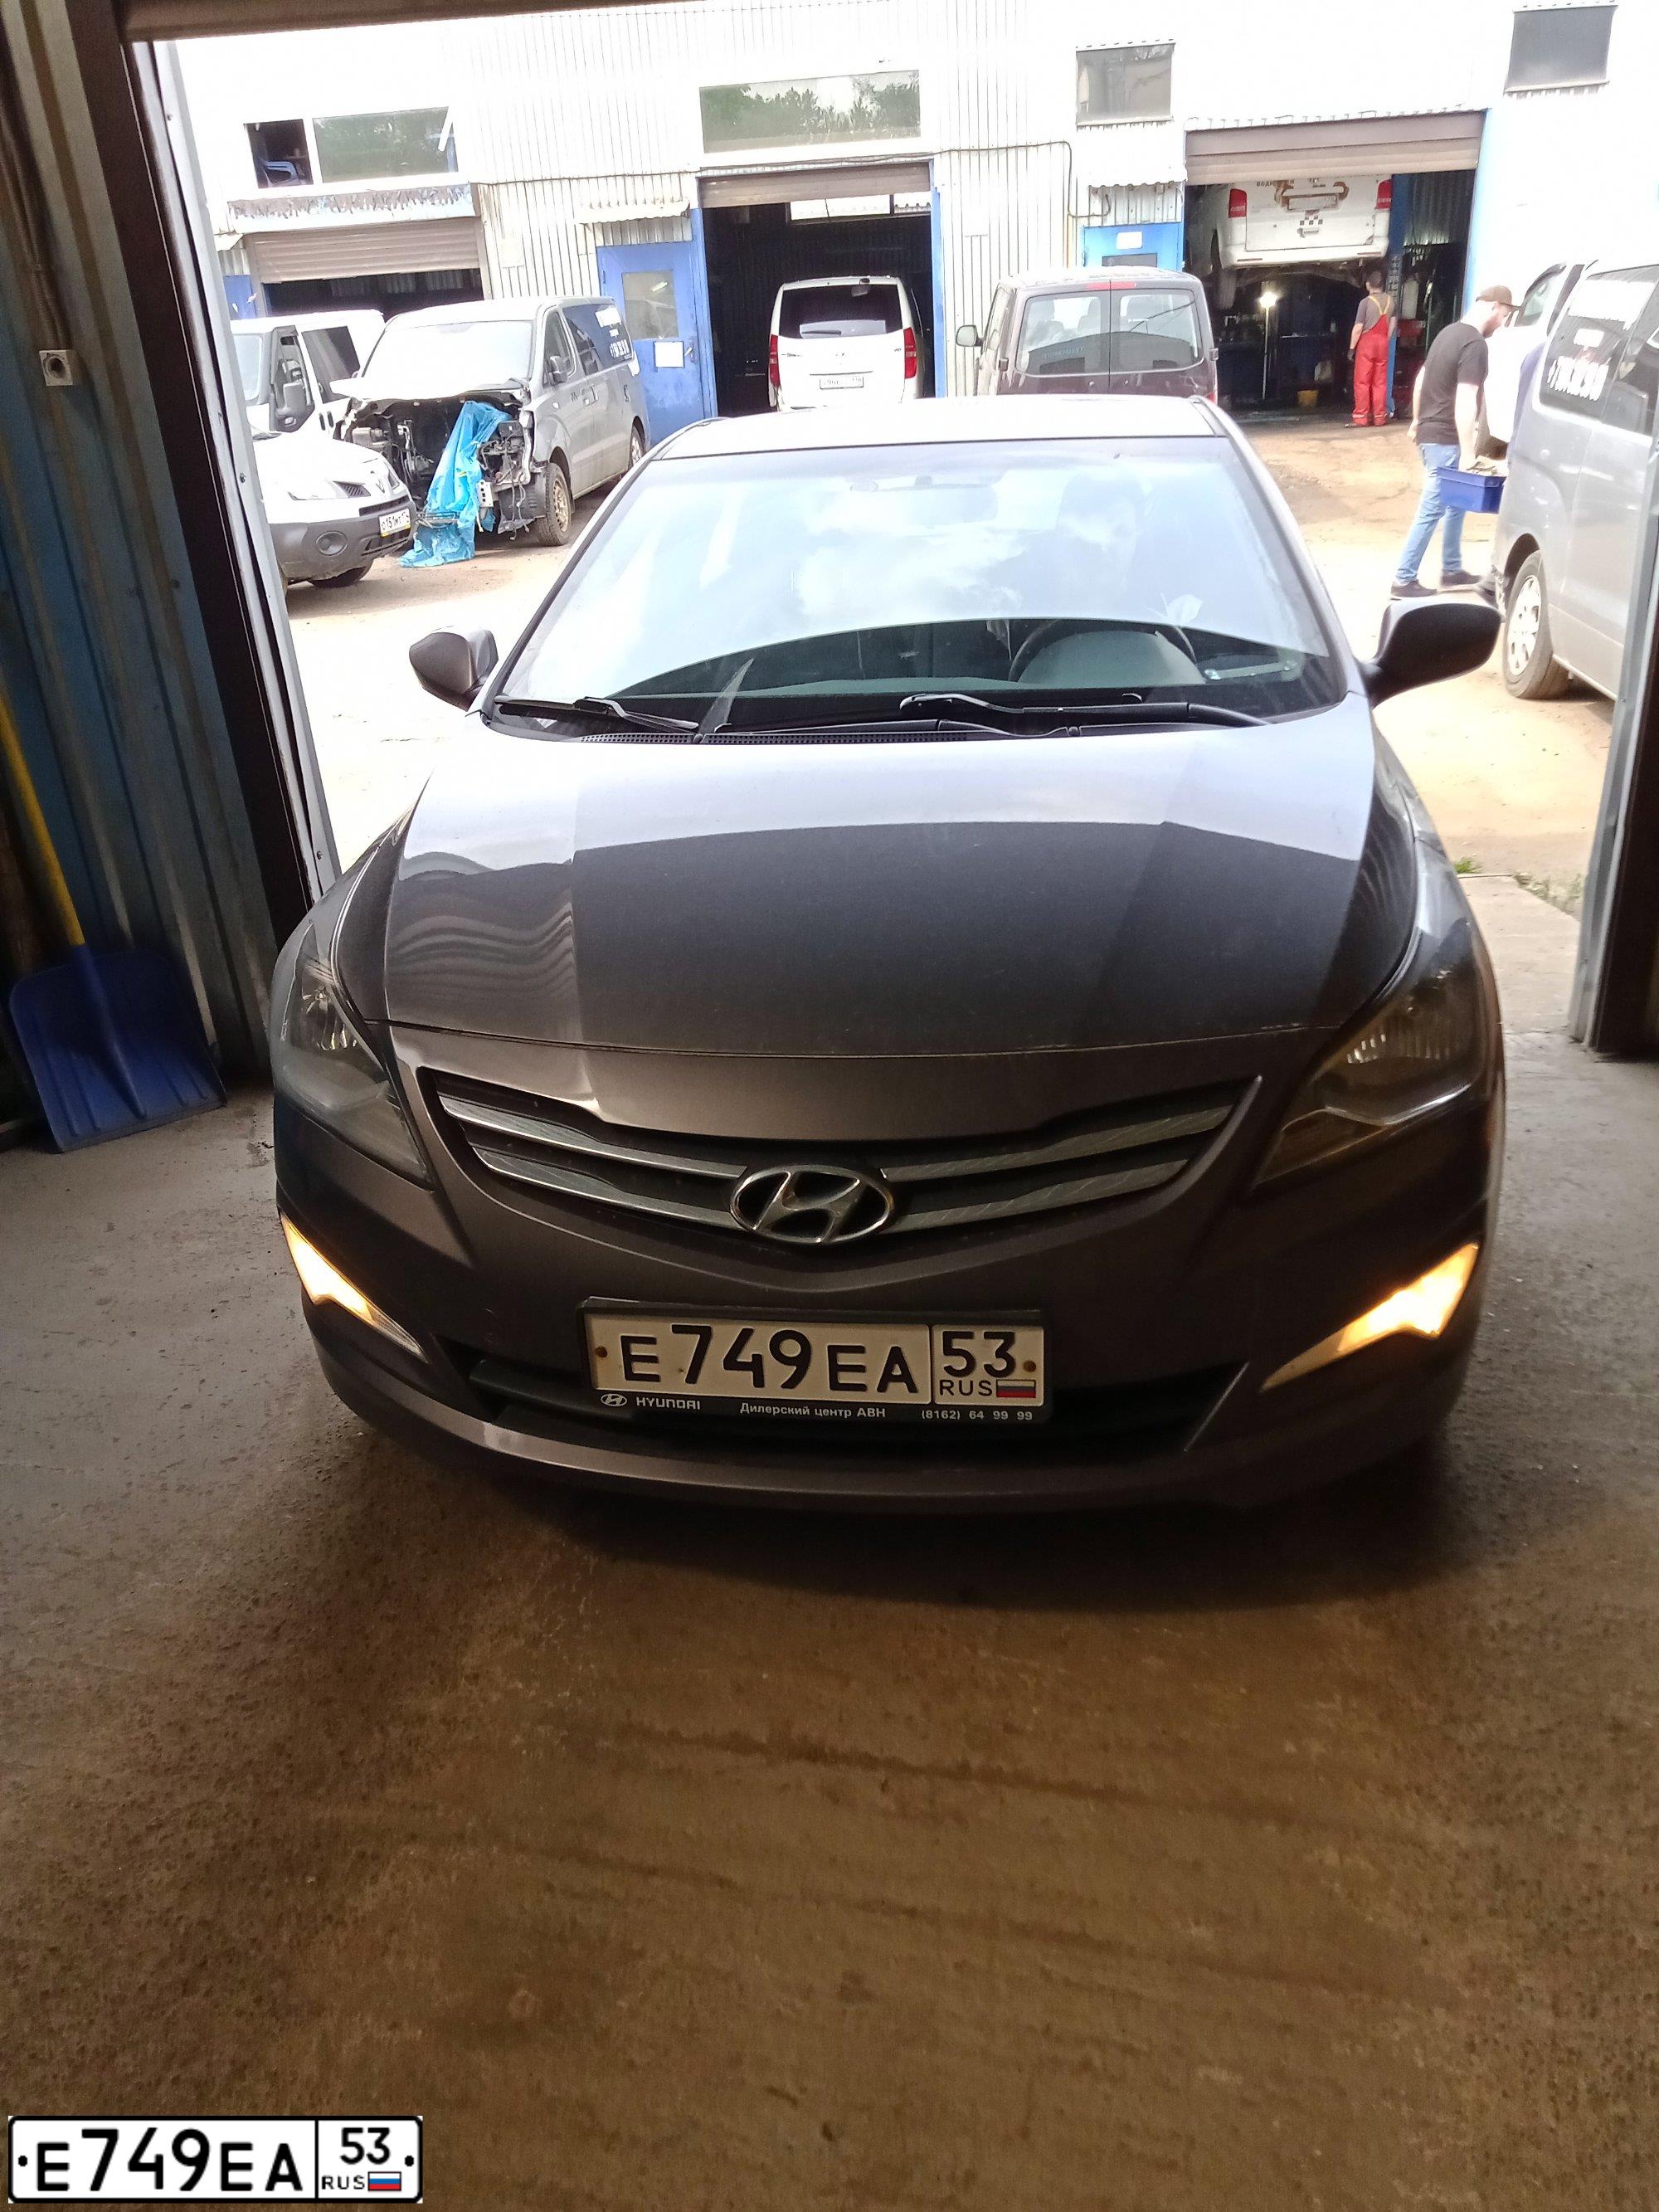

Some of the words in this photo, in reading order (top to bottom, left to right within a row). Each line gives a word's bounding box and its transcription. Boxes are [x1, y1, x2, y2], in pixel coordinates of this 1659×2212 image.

[942, 1330, 1016, 1378] 53
[939, 1378, 993, 1398] RUS
[635, 1396, 701, 1411] HYUNDAI
[740, 1402, 810, 1417] Дилерский
[815, 1408, 852, 1419] центр
[922, 1410, 961, 1420] (8162)
[969, 1411, 985, 1420] 64
[992, 1411, 1009, 1420] 99
[1016, 1411, 1033, 1421] 99
